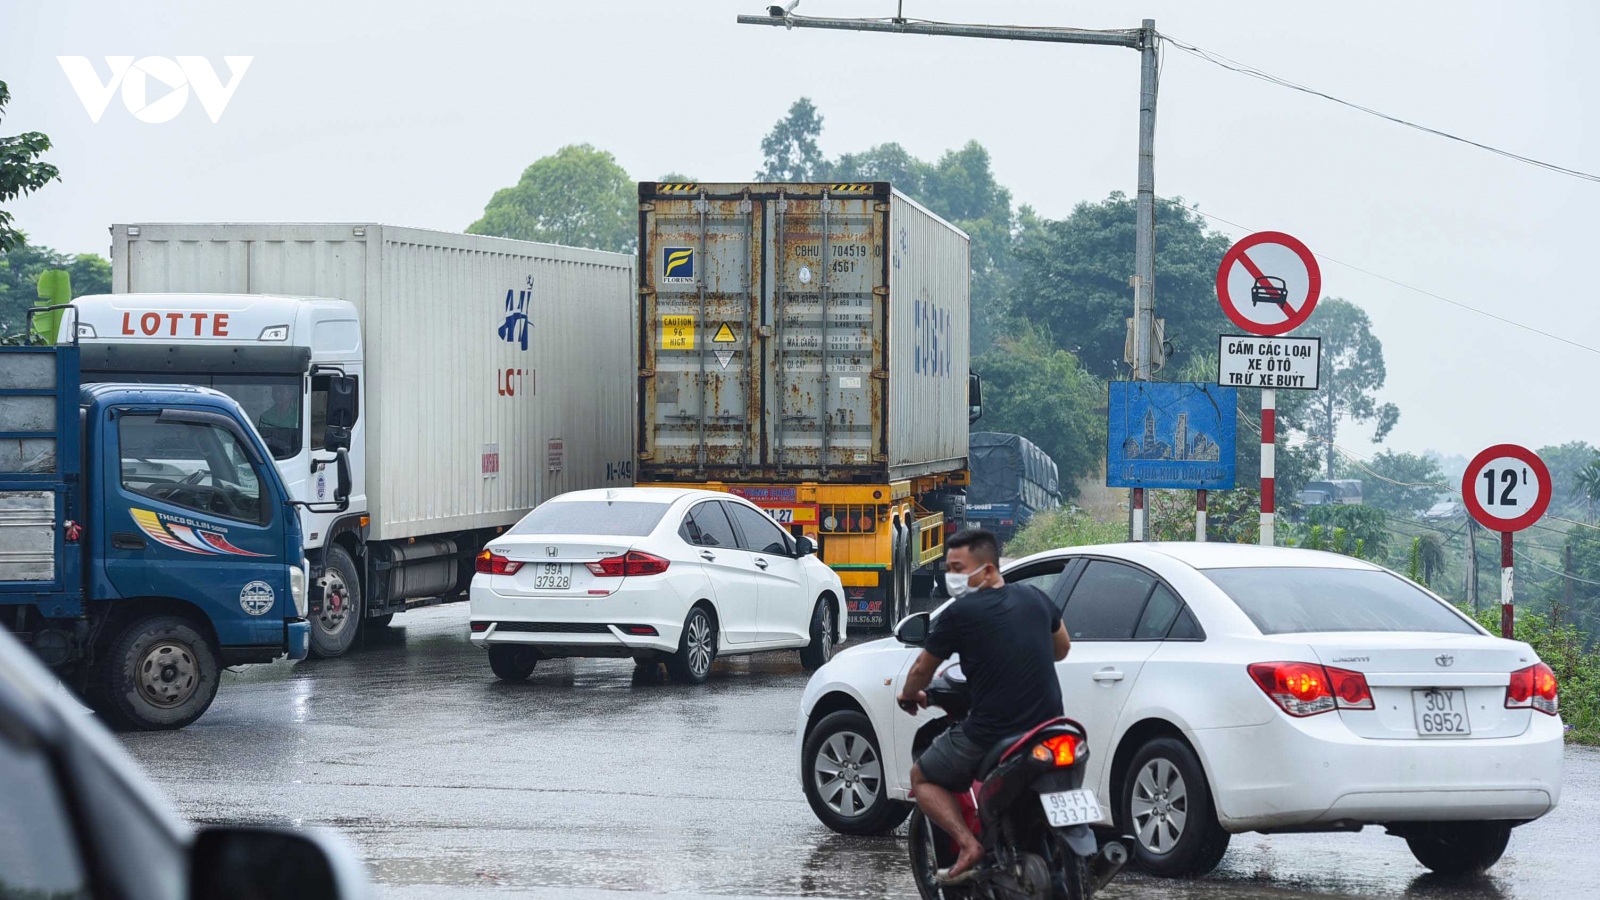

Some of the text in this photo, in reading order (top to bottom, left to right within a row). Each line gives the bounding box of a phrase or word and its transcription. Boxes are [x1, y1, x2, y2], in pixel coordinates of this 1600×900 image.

[795, 245, 819, 257] CBHU
[832, 244, 866, 257] 704519
[832, 261, 854, 272] 45G1
[121, 312, 230, 337] LOTTE
[664, 318, 692, 327] CAUTION
[1228, 340, 1311, 359] CẤM CÁC LOẠI
[1248, 359, 1262, 370] XE
[1229, 371, 1305, 387] TRỪ XE BUÝT
[157, 512, 185, 524] THACO
[545, 563, 562, 575] 99A
[536, 576, 569, 587] 379.28
[1424, 691, 1453, 711] 30Y
[1423, 713, 1464, 732] 6952
[1050, 793, 1088, 809] 99-F1
